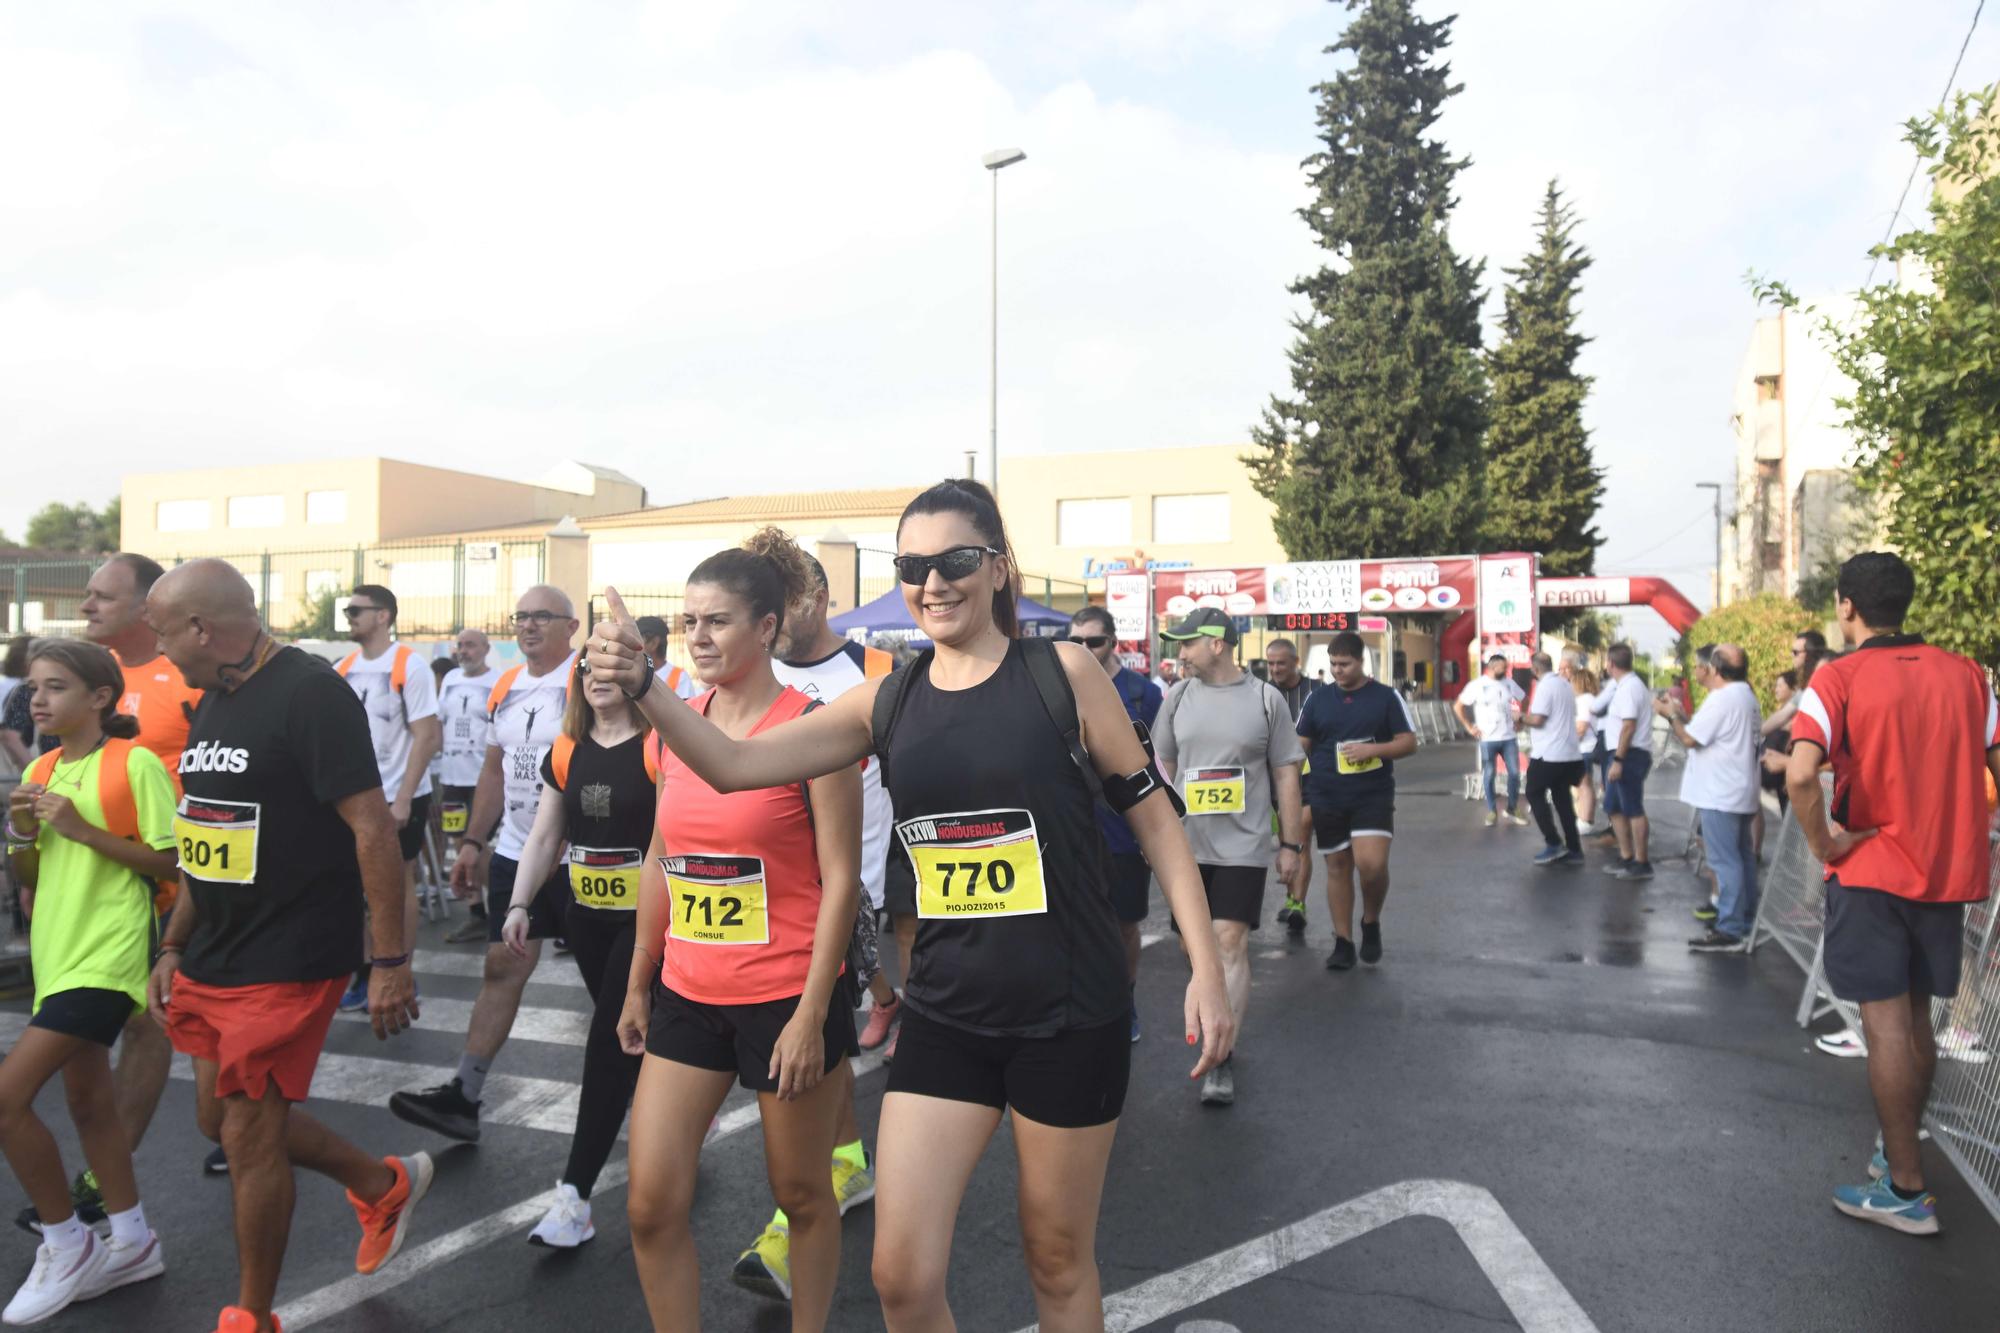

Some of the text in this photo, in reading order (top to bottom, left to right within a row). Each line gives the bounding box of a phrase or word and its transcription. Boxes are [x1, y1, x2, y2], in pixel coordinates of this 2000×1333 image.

[1296, 565, 1352, 575] XXVIII
[1296, 577, 1353, 588] NON
[1286, 613, 1348, 630] 0:01:25
[513, 753, 537, 761] NON
[513, 771, 537, 781] MAS
[1195, 788, 1233, 804] 752
[902, 820, 938, 844] XXVIII
[937, 821, 1007, 840] NONDUERMAS
[182, 837, 230, 869] 801
[936, 859, 1015, 897] 770
[581, 876, 626, 898] 806
[682, 893, 744, 927] 712
[946, 902, 1006, 912] PIOJOZI2015
[693, 931, 725, 940] CONSUE
